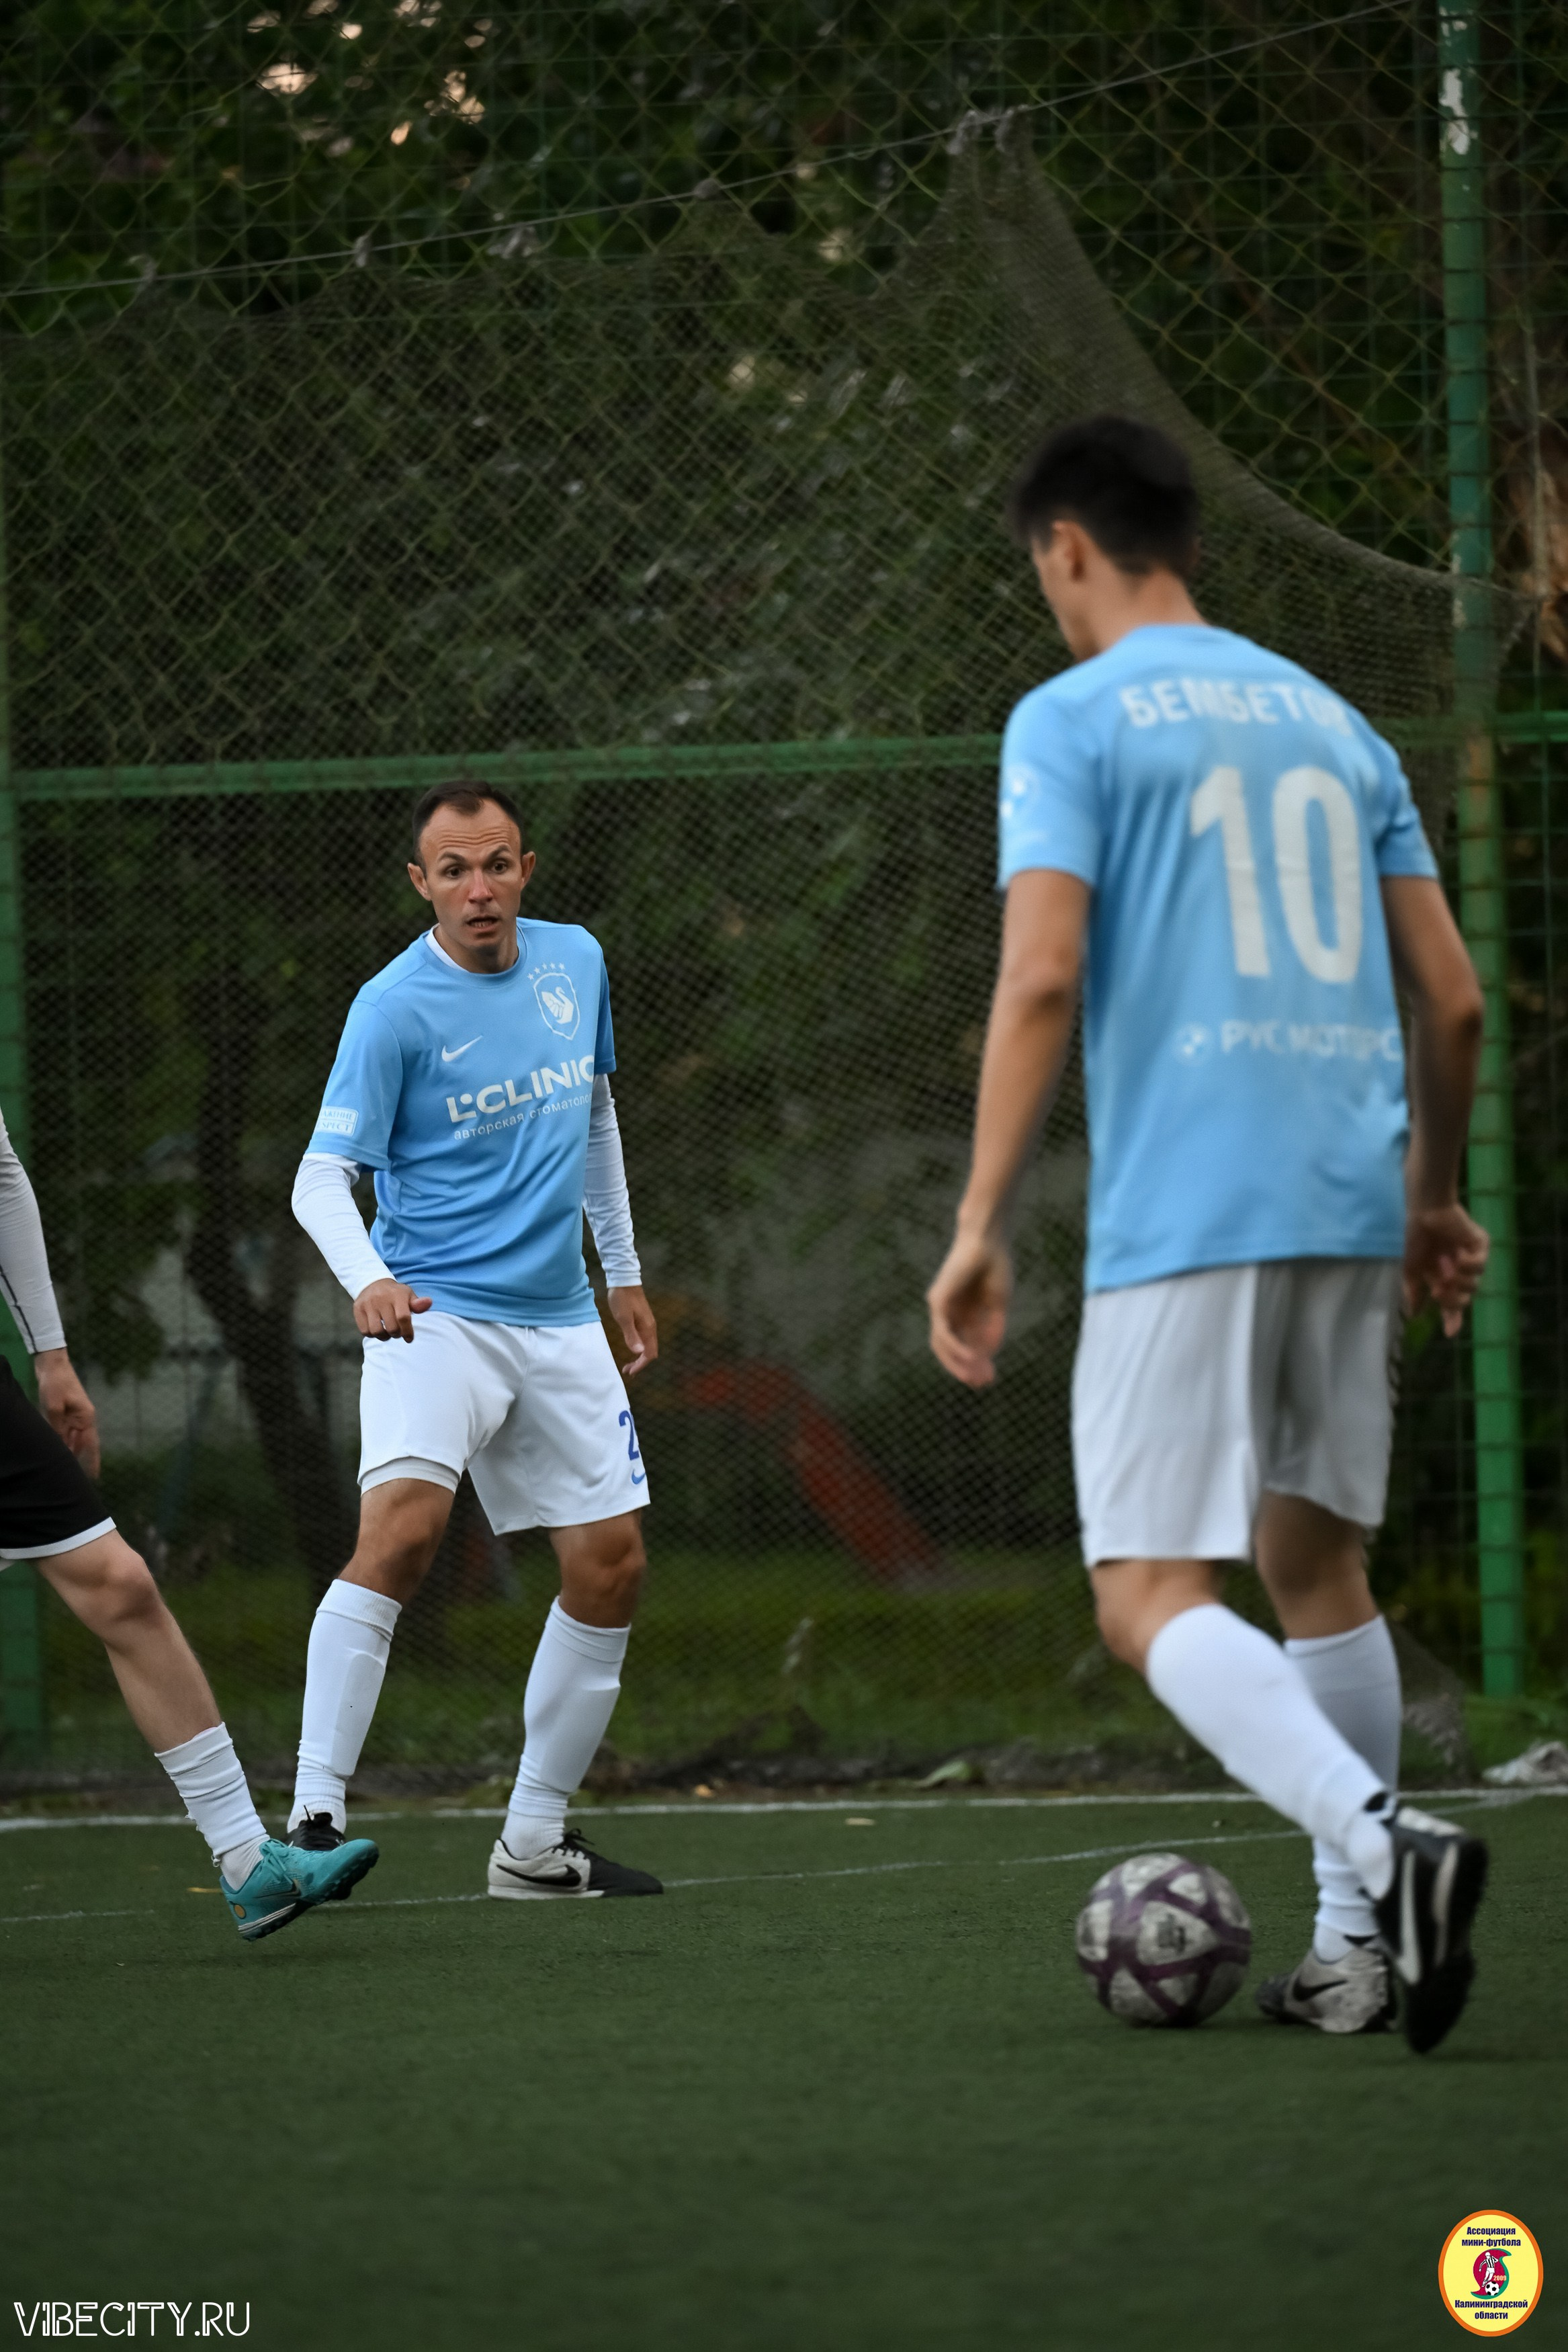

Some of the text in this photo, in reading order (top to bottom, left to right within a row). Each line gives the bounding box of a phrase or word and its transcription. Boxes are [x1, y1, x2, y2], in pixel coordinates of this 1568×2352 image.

[1190, 765, 1362, 984] 10
[454, 1112, 525, 1140] авторская
[619, 1410, 640, 1461] 2
